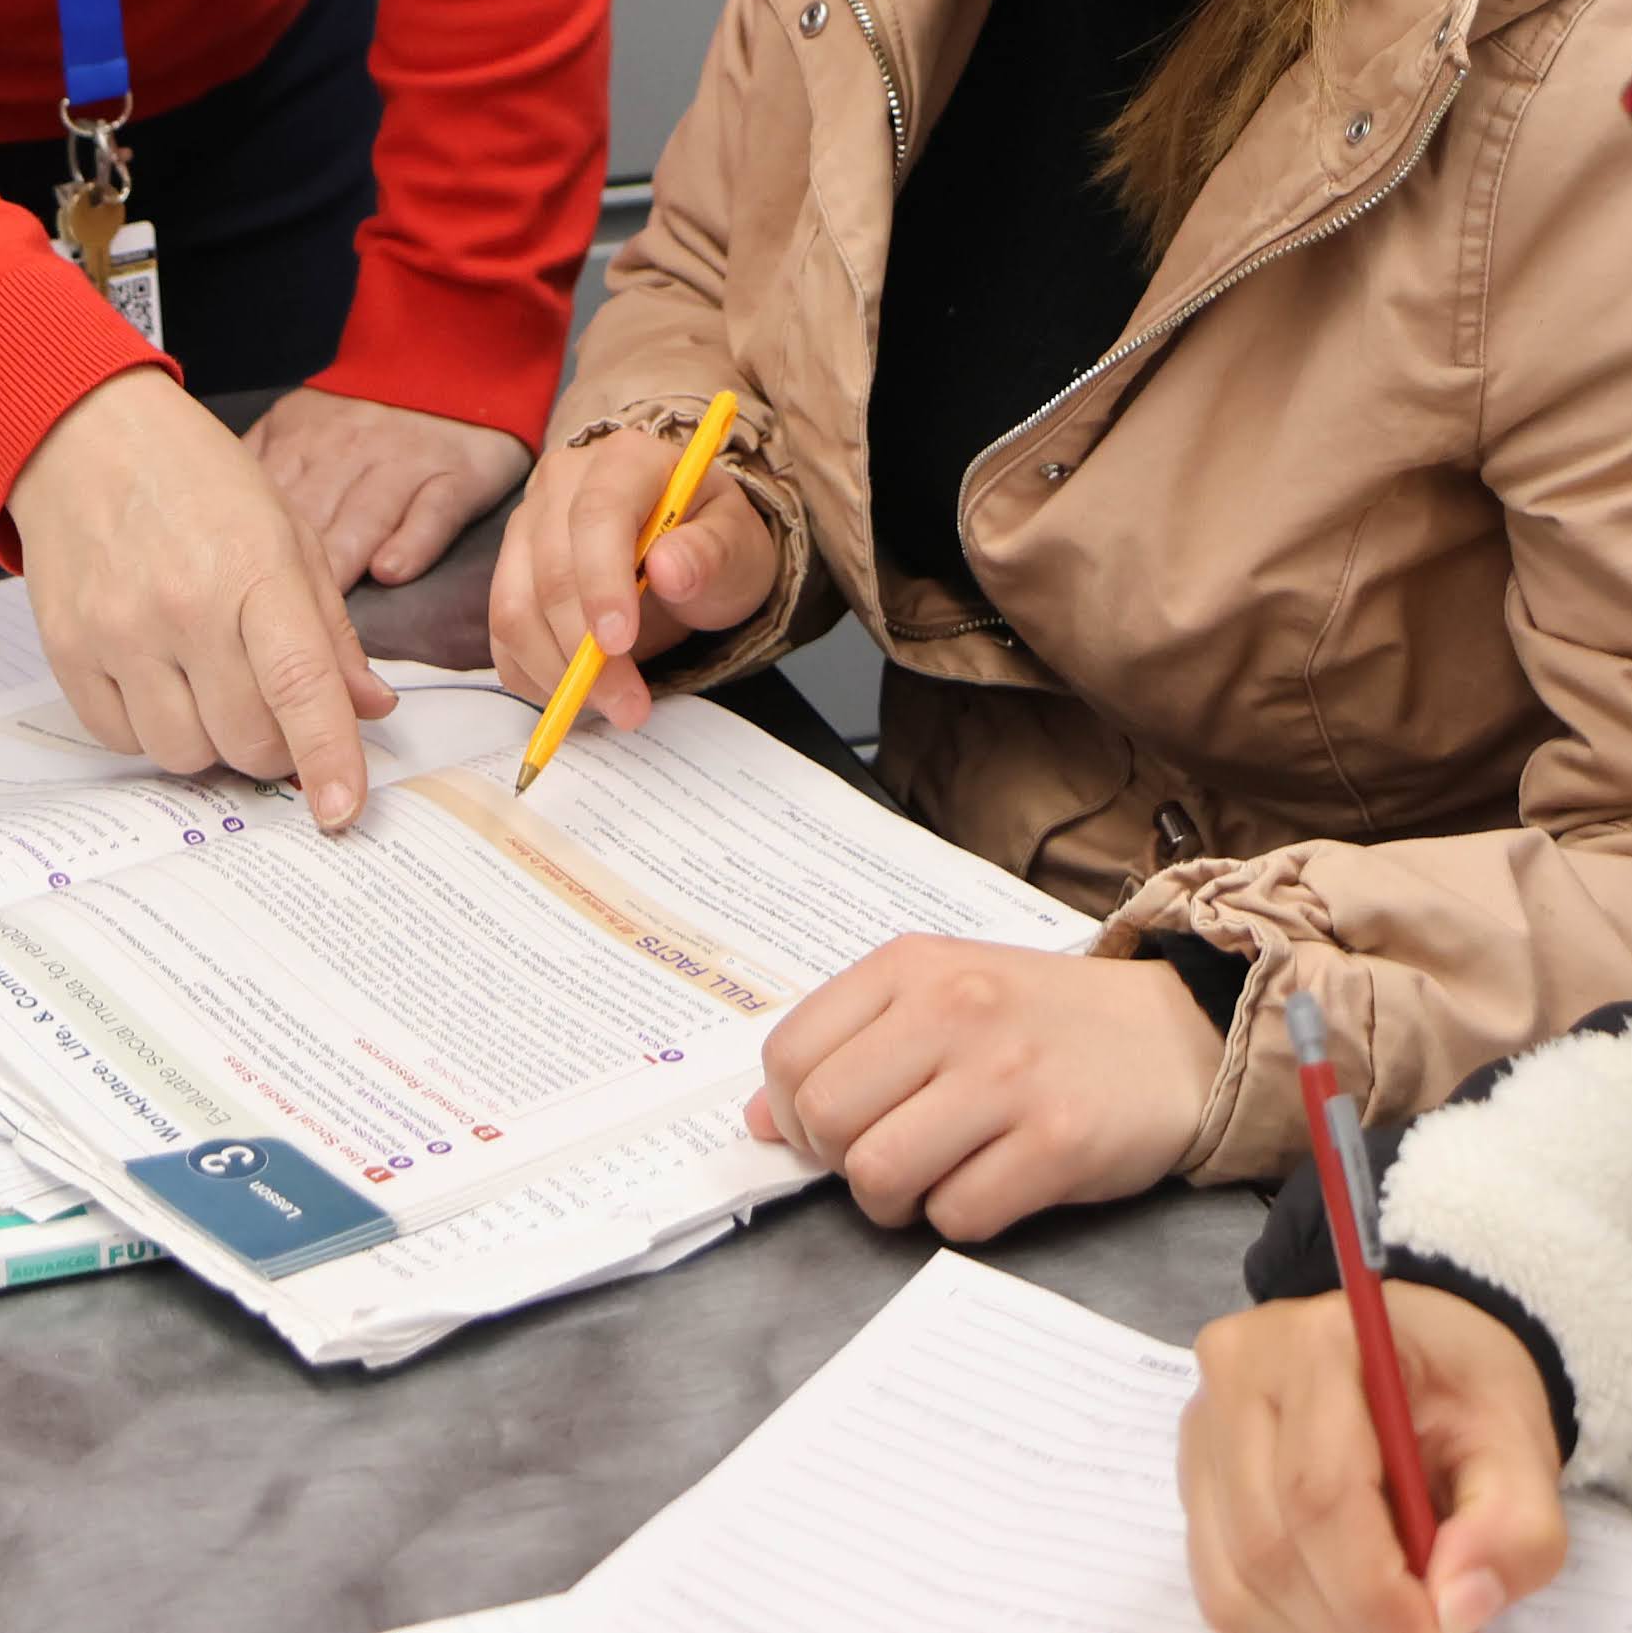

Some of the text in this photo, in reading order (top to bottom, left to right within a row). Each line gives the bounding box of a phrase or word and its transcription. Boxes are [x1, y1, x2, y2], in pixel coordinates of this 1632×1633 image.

[40, 960, 69, 980] for
[635, 936, 766, 1010] FULL FACTS
[32, 1010, 54, 1023] &
[65, 979, 117, 1024] media
[55, 1024, 90, 1060] Life,
[108, 1025, 163, 1066] social
[223, 1055, 258, 1083] Sites
[354, 1038, 423, 1089] Resources
[92, 1060, 180, 1142] Workplace,
[159, 1067, 230, 1125] Evaluate
[257, 1082, 298, 1114] Media
[420, 1088, 475, 1124] Consult
[294, 1113, 339, 1146] Social
[339, 1145, 367, 1166] Use
[200, 1146, 301, 1218] Lesson 3
[107, 1240, 162, 1265] FUT
